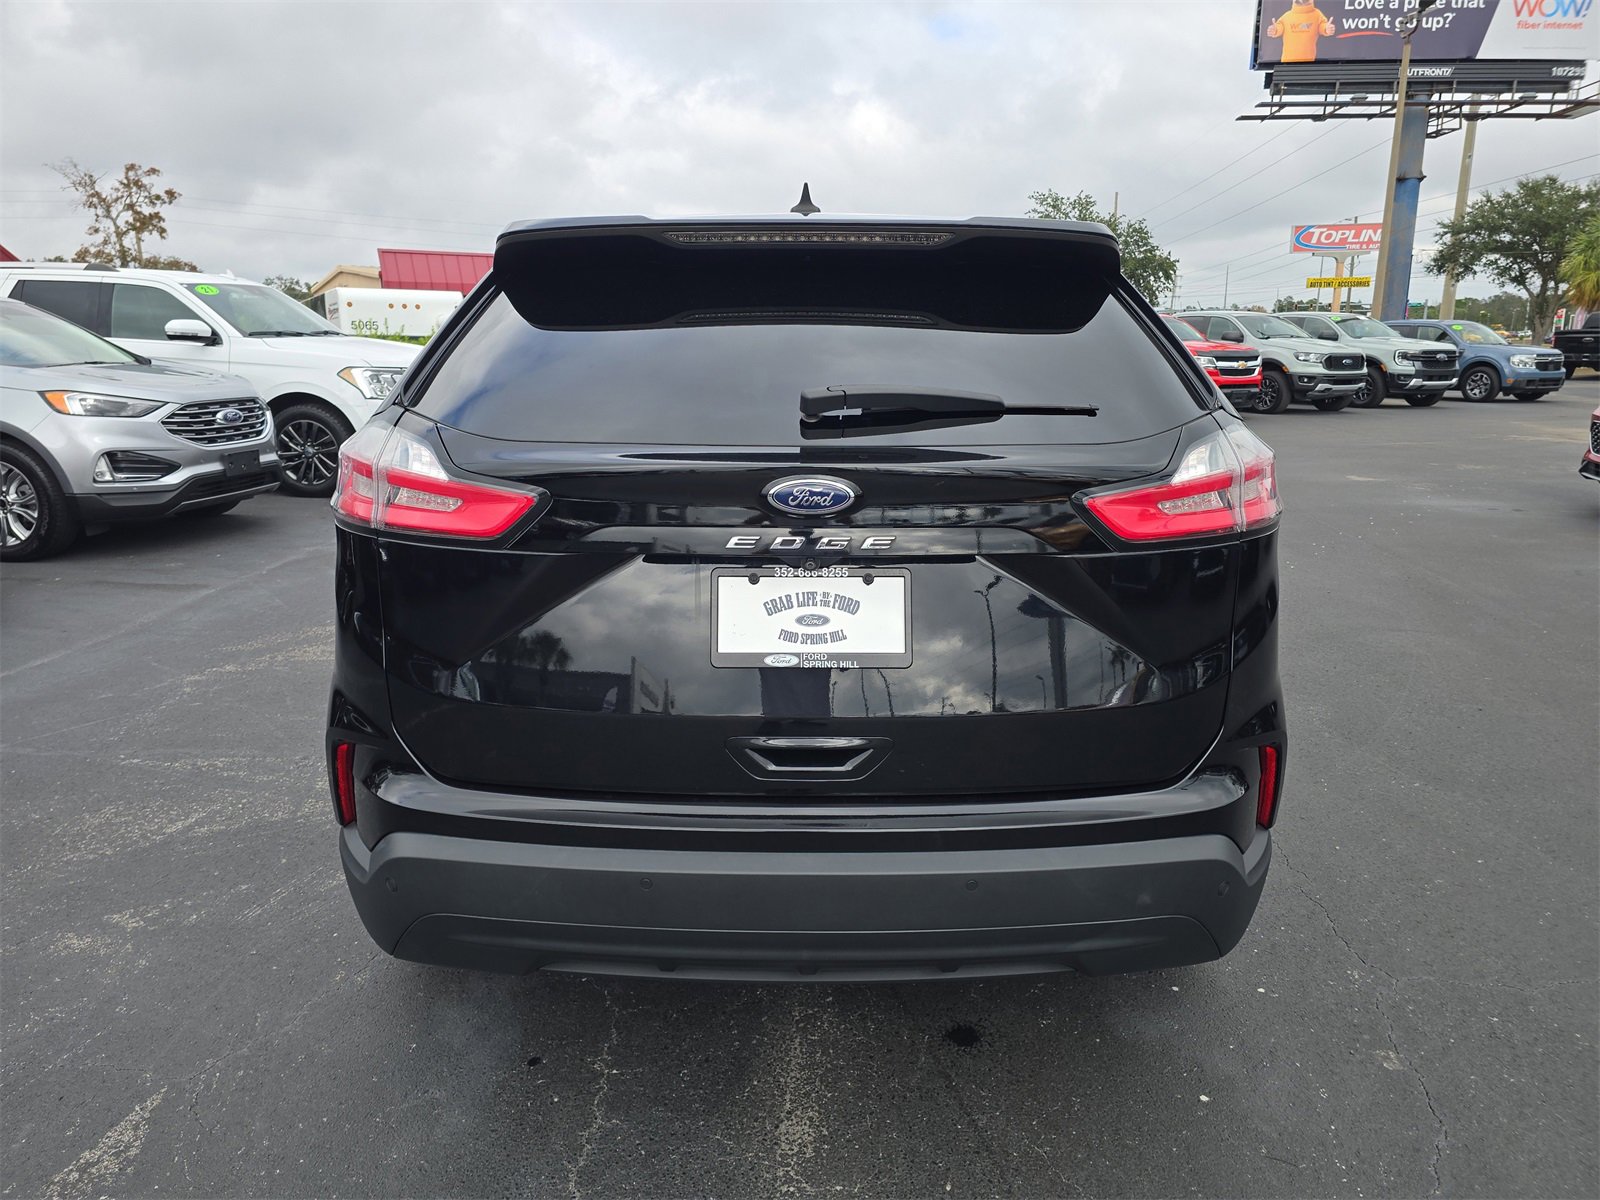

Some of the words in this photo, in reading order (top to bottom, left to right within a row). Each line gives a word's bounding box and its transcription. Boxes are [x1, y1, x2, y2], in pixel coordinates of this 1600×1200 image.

[1344, 0, 1385, 9] Love
[1389, 0, 1399, 9] a
[1451, 0, 1486, 9] that
[1513, 0, 1592, 17] WOW!
[1342, 13, 1391, 29] won't
[1516, 20, 1541, 30] fiber
[1543, 20, 1583, 30] internet
[1308, 228, 1382, 244] TOPLIN
[1338, 280, 1370, 288] ACCESSORIES
[351, 320, 379, 331] 5065
[788, 486, 835, 506] Ford
[725, 536, 896, 550] EDGE
[763, 594, 794, 616] GRAB
[795, 591, 818, 608] LIFE
[832, 593, 860, 615] FORD
[801, 615, 824, 625] Ford
[778, 629, 799, 644] FORD
[800, 632, 828, 645] SPRING
[829, 629, 847, 643] HILL
[770, 656, 792, 664] Ford
[803, 652, 827, 660] FORD
[803, 660, 837, 668] SPRING
[840, 660, 859, 668] HILL
